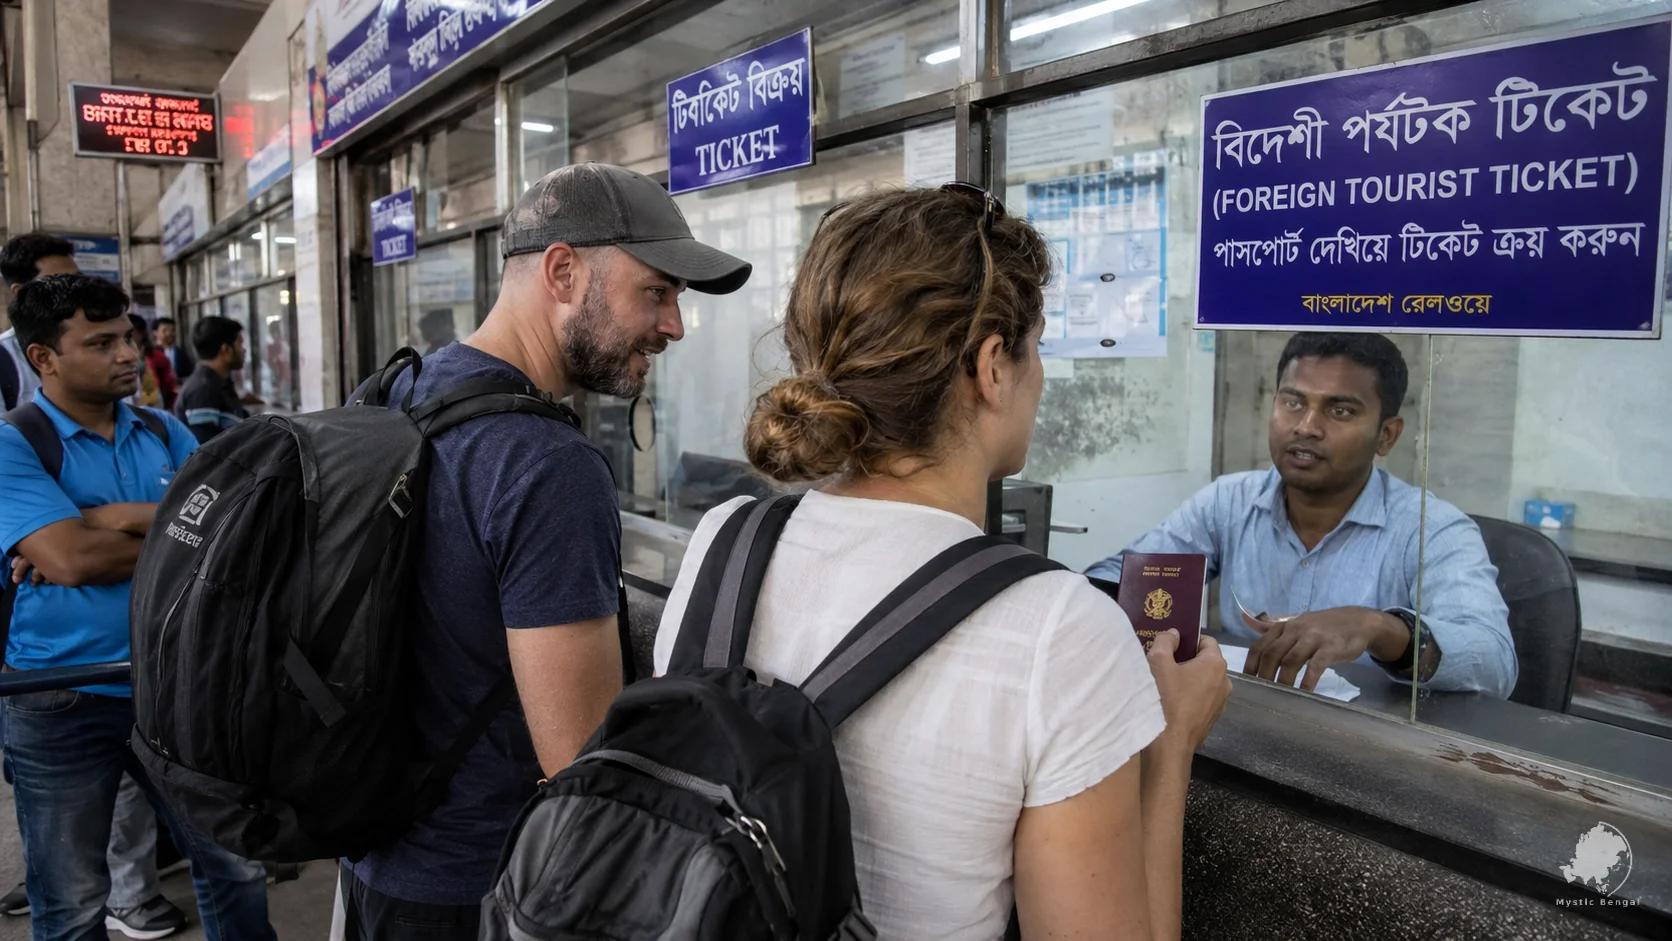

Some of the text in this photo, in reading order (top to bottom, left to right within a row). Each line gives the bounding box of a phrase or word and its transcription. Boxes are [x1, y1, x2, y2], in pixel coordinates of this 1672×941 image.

[746, 57, 805, 111] বিক্রয়
[1211, 61, 1658, 170] বিদেশী পর্যটক টিকেট
[695, 124, 780, 176] TICKET
[1213, 180, 1335, 221] (FOREIGN
[1345, 167, 1480, 205] TOURIST
[1489, 152, 1638, 195] TICKET)
[1213, 219, 1646, 267] পাসপোর্ট দেখিয়ে টিকেট ক্রয় করুন
[1301, 292, 1493, 315] বাংলাদেশ রেলওয়ে
